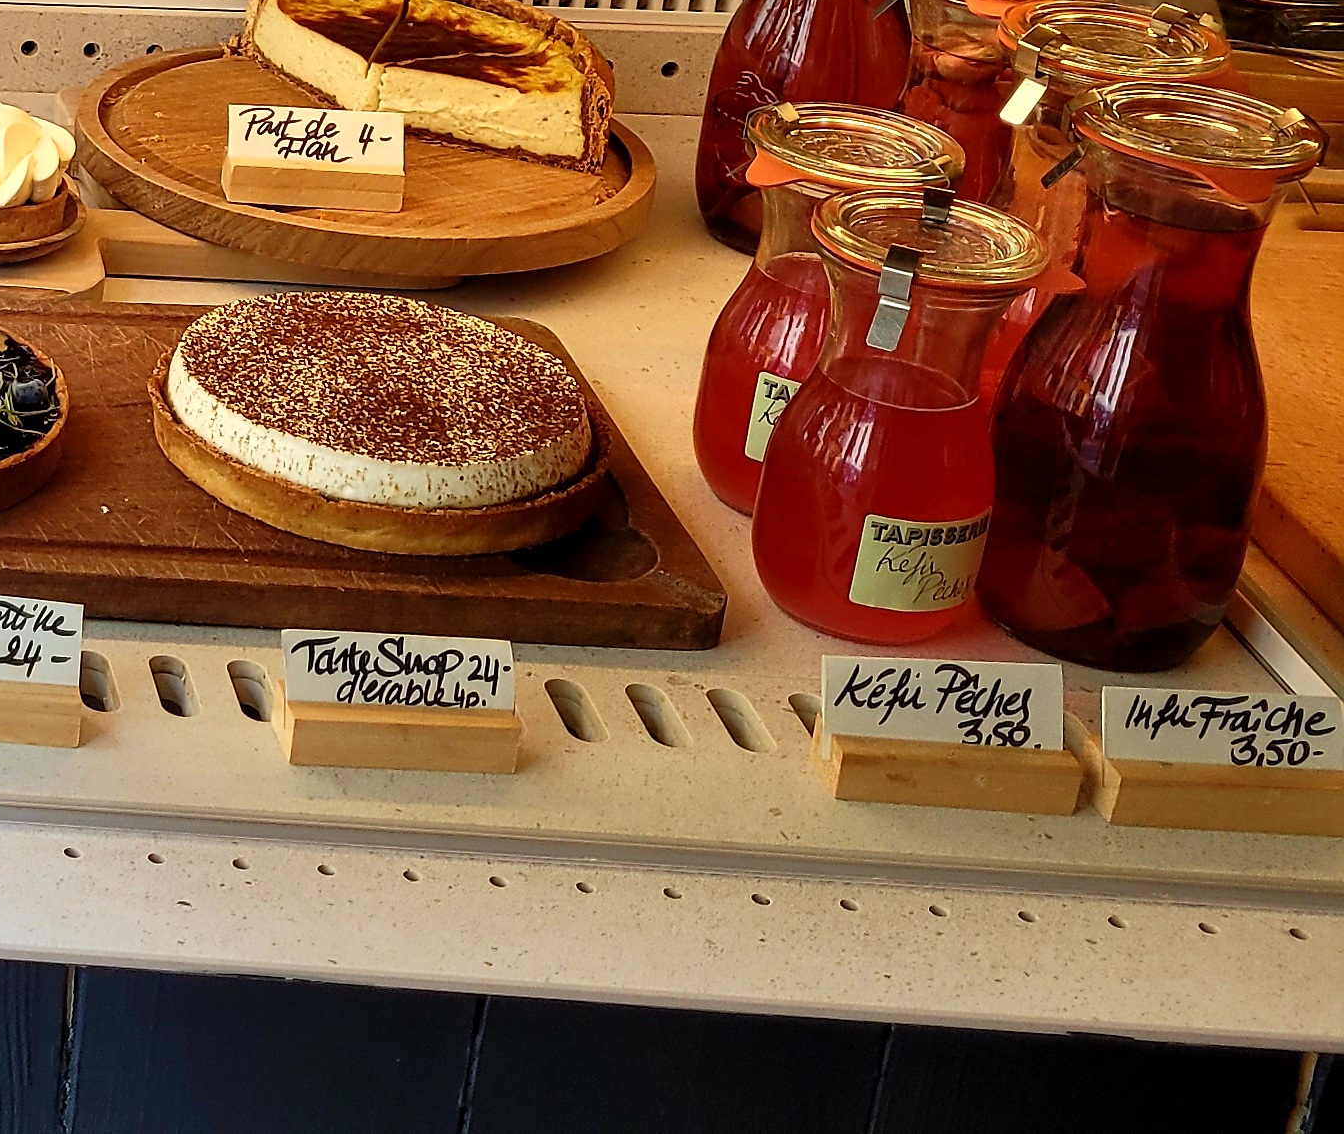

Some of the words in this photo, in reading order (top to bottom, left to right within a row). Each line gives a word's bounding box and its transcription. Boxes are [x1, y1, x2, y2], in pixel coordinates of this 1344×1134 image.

[238, 107, 303, 142] Part
[304, 112, 341, 140] de
[274, 136, 354, 163] Flan
[290, 636, 372, 675] Tarte
[373, 636, 465, 679] Sirop
[934, 664, 1033, 723] Pêches
[1125, 693, 1197, 741] Infu
[1191, 695, 1336, 740] Fraîche
